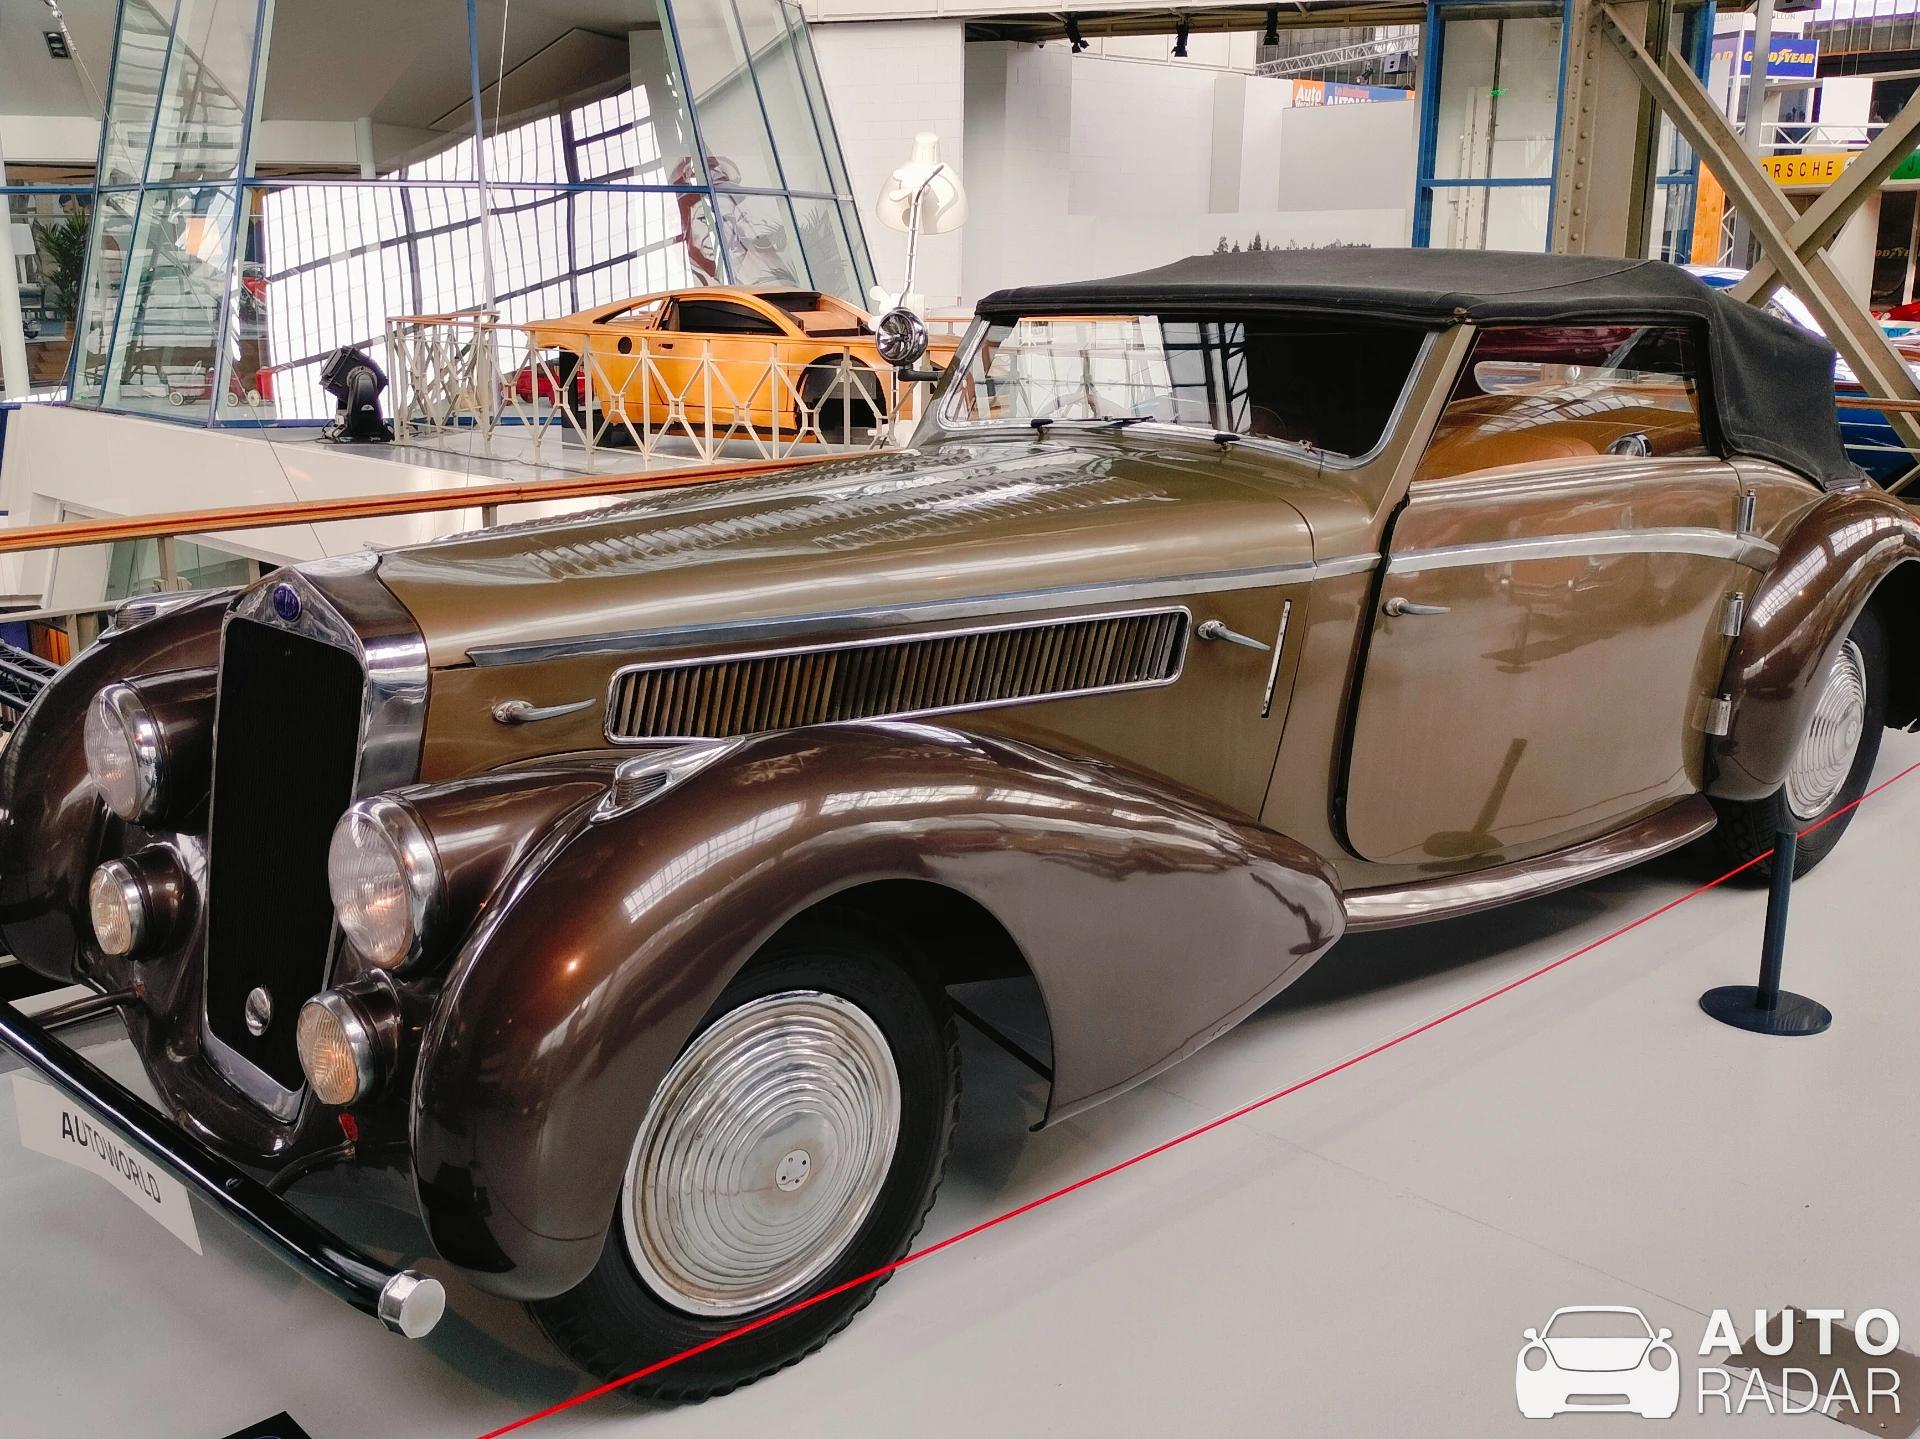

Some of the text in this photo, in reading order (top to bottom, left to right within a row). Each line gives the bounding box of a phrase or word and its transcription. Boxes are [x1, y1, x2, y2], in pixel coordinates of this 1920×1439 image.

[1744, 49, 1815, 65] GDYEAR
[1295, 84, 1322, 103] Auto
[62, 1111, 162, 1204] AUTOWORLD
